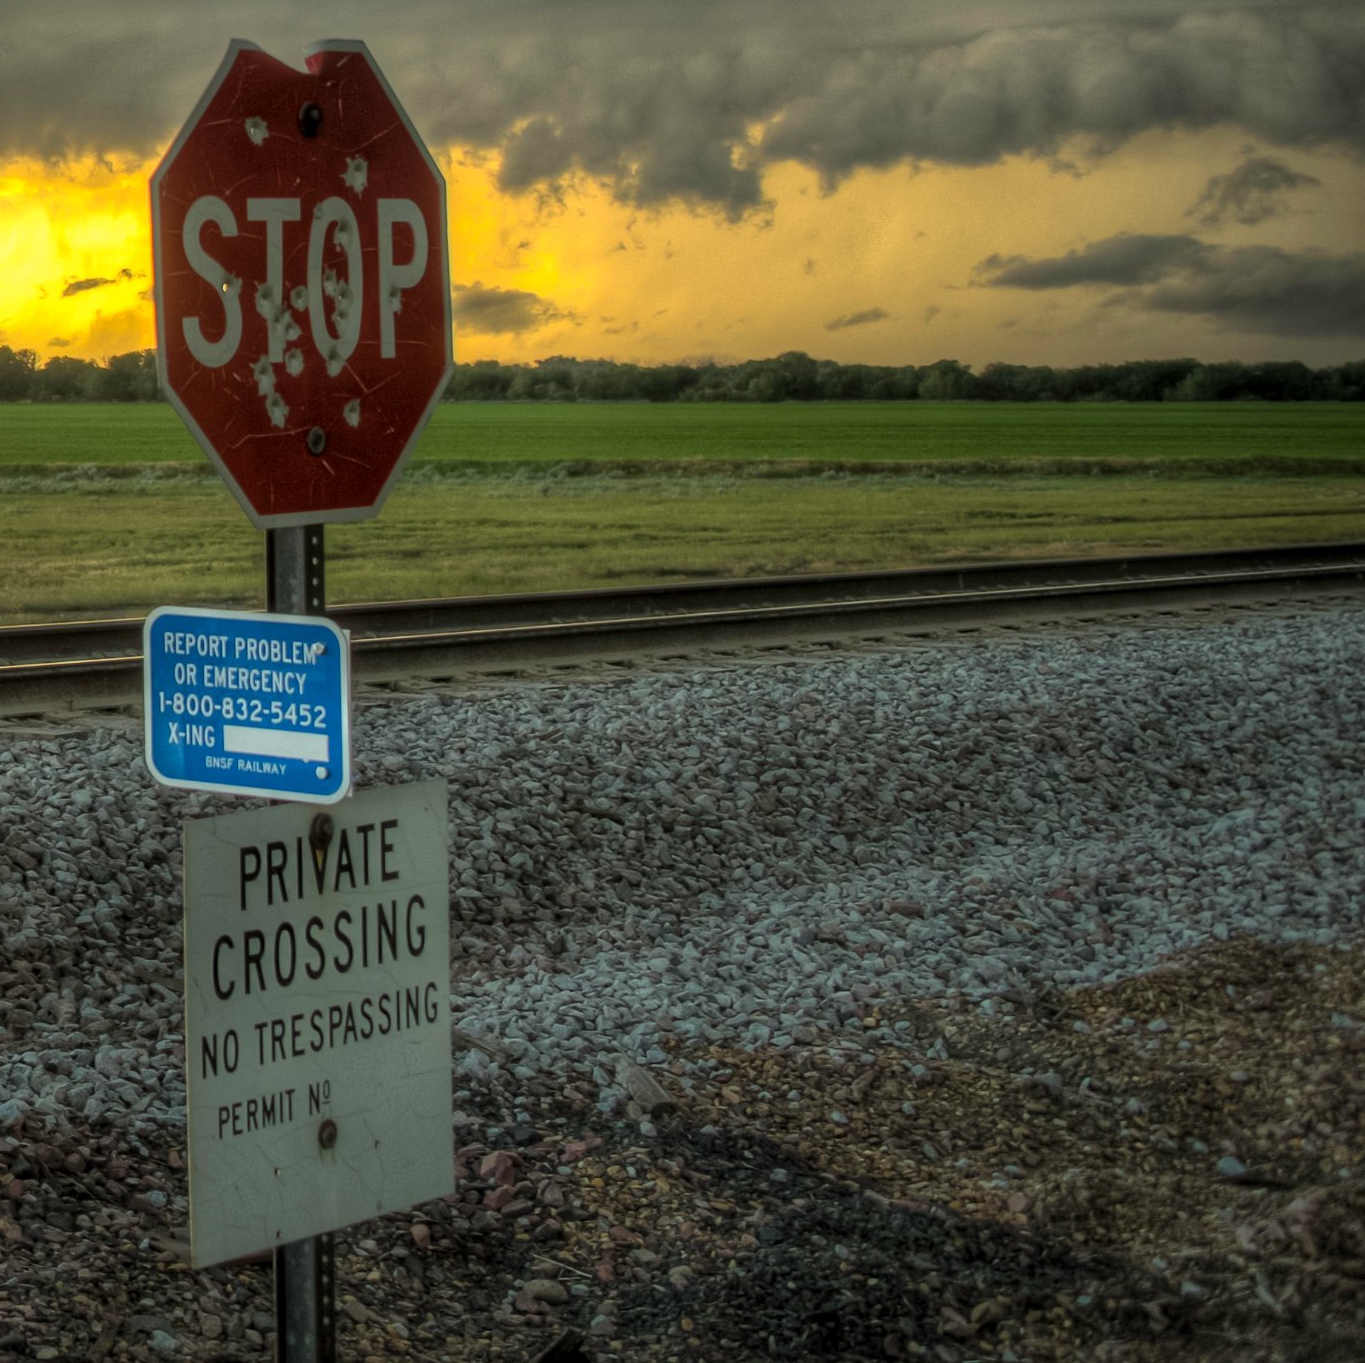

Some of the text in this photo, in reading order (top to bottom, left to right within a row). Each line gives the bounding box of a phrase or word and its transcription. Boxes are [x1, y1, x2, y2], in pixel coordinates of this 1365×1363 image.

[181, 194, 429, 369] STOP
[164, 631, 317, 666] REPORT PROBLEM
[174, 662, 307, 695] OR EMERGENCY
[158, 691, 327, 729] 1-800-832-5452
[168, 722, 216, 748] X-ING
[205, 756, 287, 775] BNSF RAILWAY
[239, 818, 400, 912] PRIVATE
[212, 893, 427, 1001] CROSSING
[201, 981, 439, 1080] NO TRESPASSING
[217, 1088, 296, 1140] PERMIT
